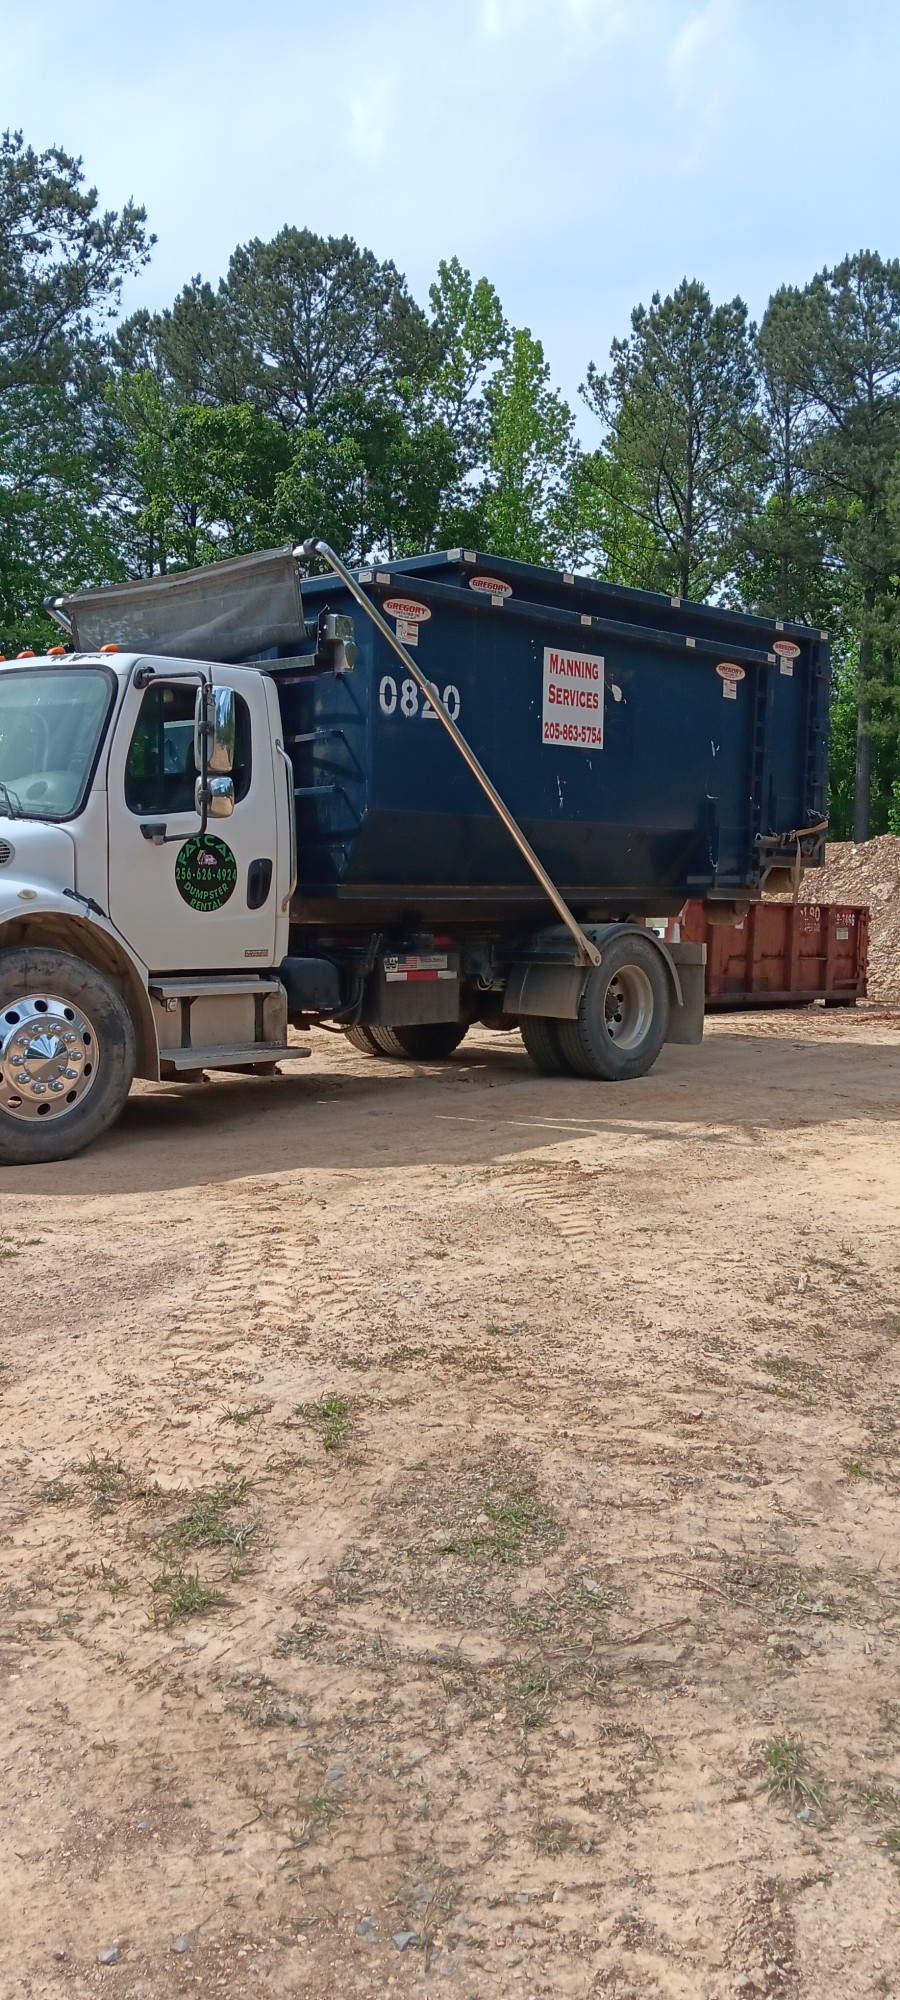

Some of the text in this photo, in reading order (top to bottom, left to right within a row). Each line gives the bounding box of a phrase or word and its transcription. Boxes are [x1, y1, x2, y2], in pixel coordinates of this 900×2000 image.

[472, 580, 508, 592] GREGORY
[386, 601, 427, 615] GREGORY
[550, 654, 599, 680] MANNING
[379, 675, 460, 721] 0820
[548, 684, 599, 709] SERVICES
[544, 721, 602, 744] 205-863-5754
[183, 881, 229, 900] DUMPSTER
[190, 899, 223, 911] RENTAL
